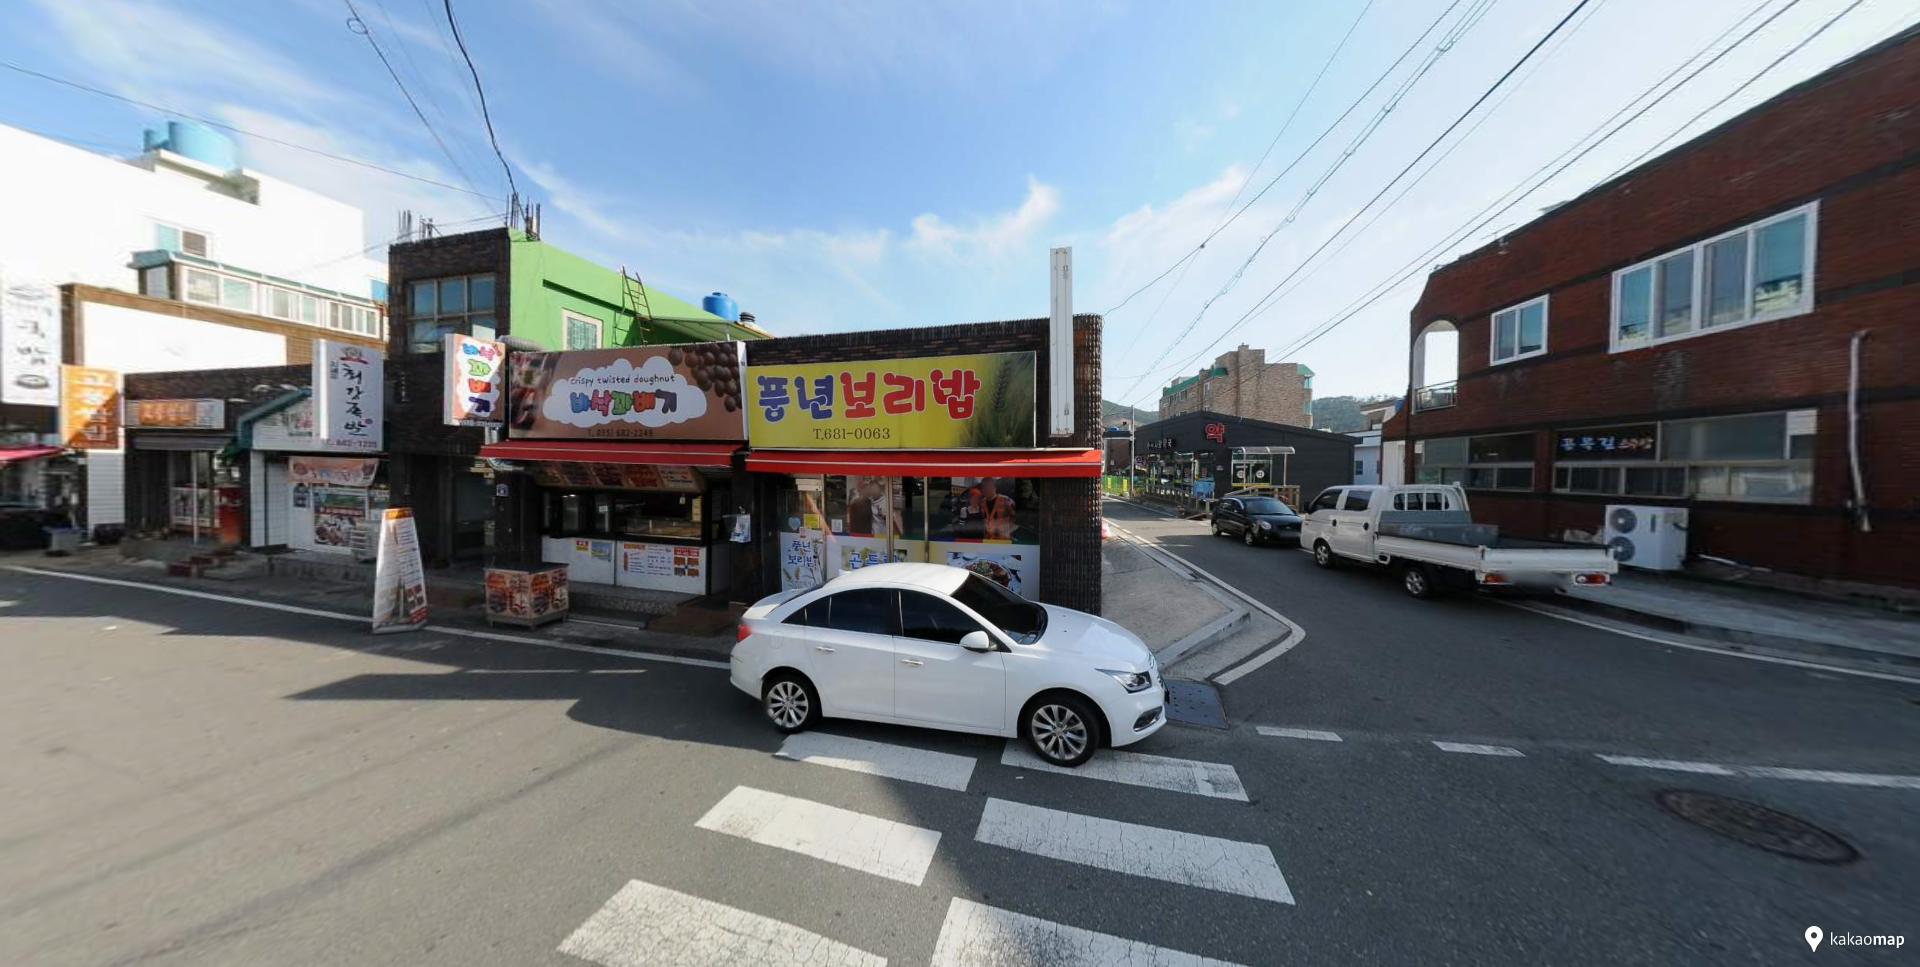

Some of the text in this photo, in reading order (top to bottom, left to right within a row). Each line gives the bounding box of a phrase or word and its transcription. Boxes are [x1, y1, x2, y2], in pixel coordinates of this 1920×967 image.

[570, 374, 675, 386] crispy twisted doughnut
[757, 369, 981, 422] 풍년보리밥
[812, 427, 891, 441] T.681-0063
[1204, 423, 1225, 442] 약
